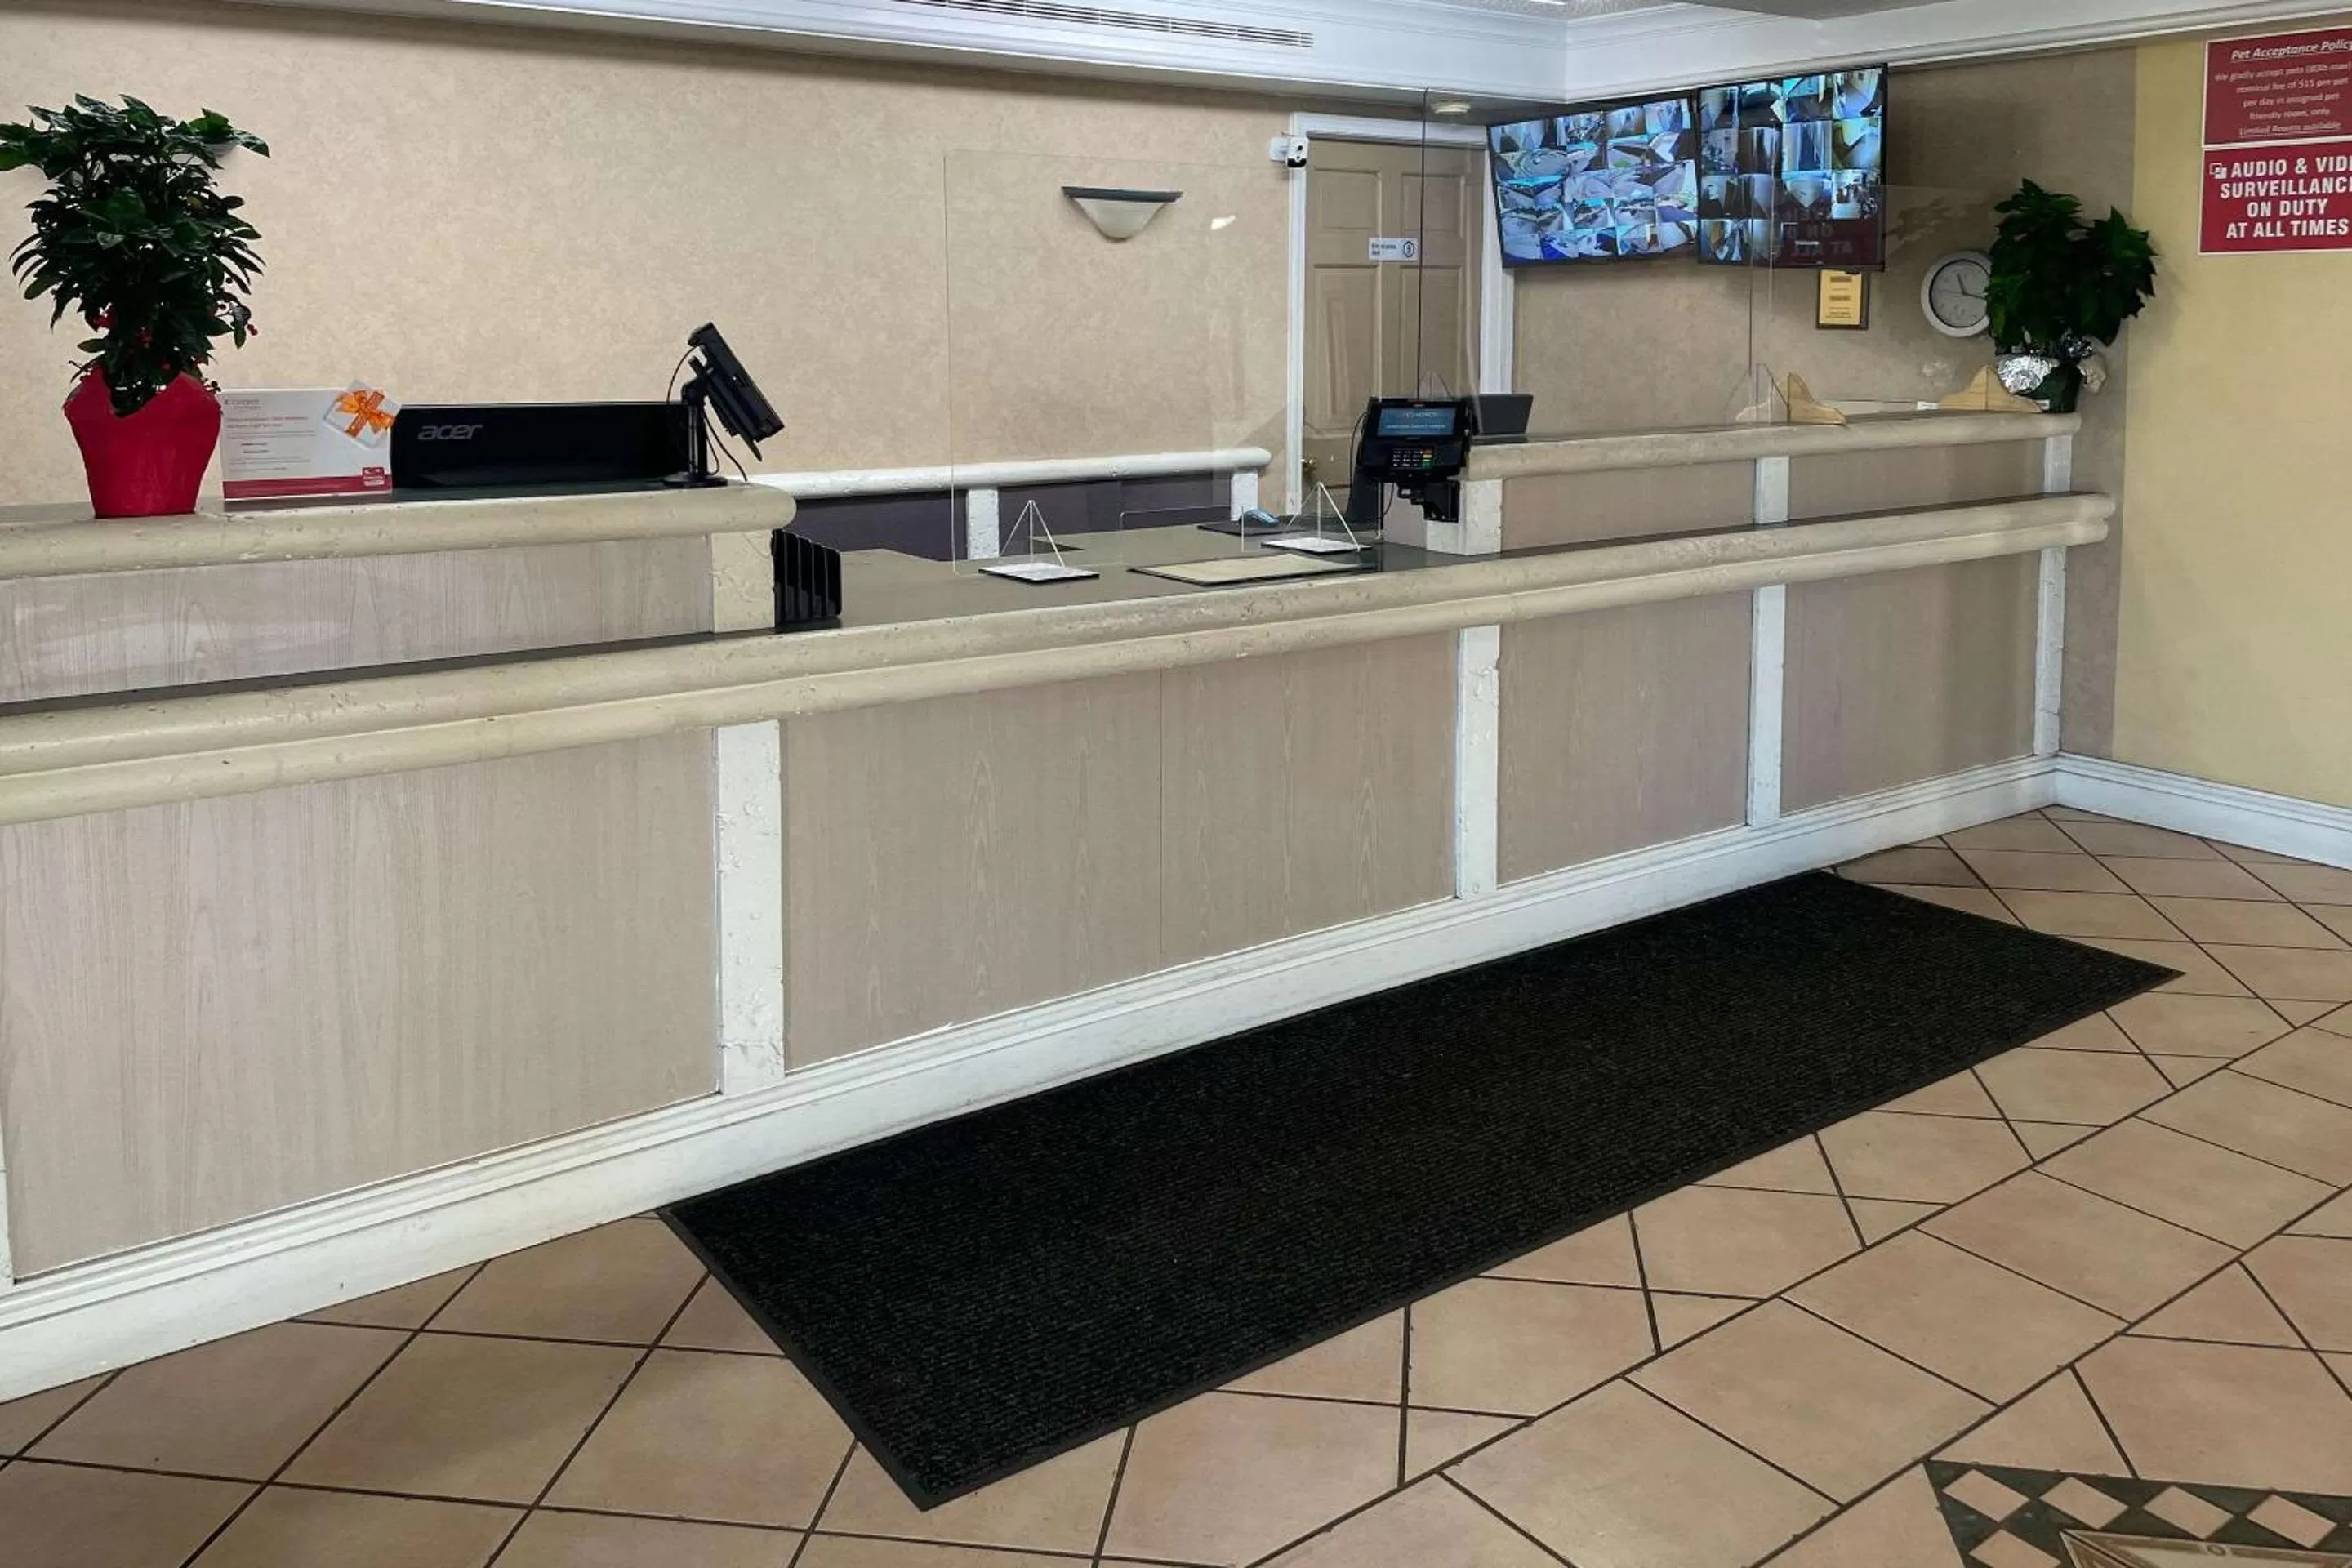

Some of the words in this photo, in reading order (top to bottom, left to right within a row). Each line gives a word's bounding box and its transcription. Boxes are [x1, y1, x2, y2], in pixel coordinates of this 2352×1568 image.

[2231, 49, 2251, 60] Pet
[2252, 43, 2318, 58] Acceptance
[2236, 82, 2270, 93] nominal
[2272, 79, 2286, 90] fee
[2287, 78, 2297, 88] of
[2243, 99, 2256, 109] per
[2259, 96, 2274, 107] day
[2286, 92, 2323, 105] assigned
[2249, 109, 2282, 121] friendly
[2238, 125, 2271, 136] Limited
[2230, 159, 2287, 178] AUDIO
[2295, 158, 2308, 174] &
[2247, 201, 2271, 218] ON
[2279, 198, 2328, 216] DUTY
[2226, 222, 2247, 239] AT
[2252, 220, 2285, 238] ALL
[2290, 218, 2350, 236] TIMES
[417, 424, 483, 440] acer
